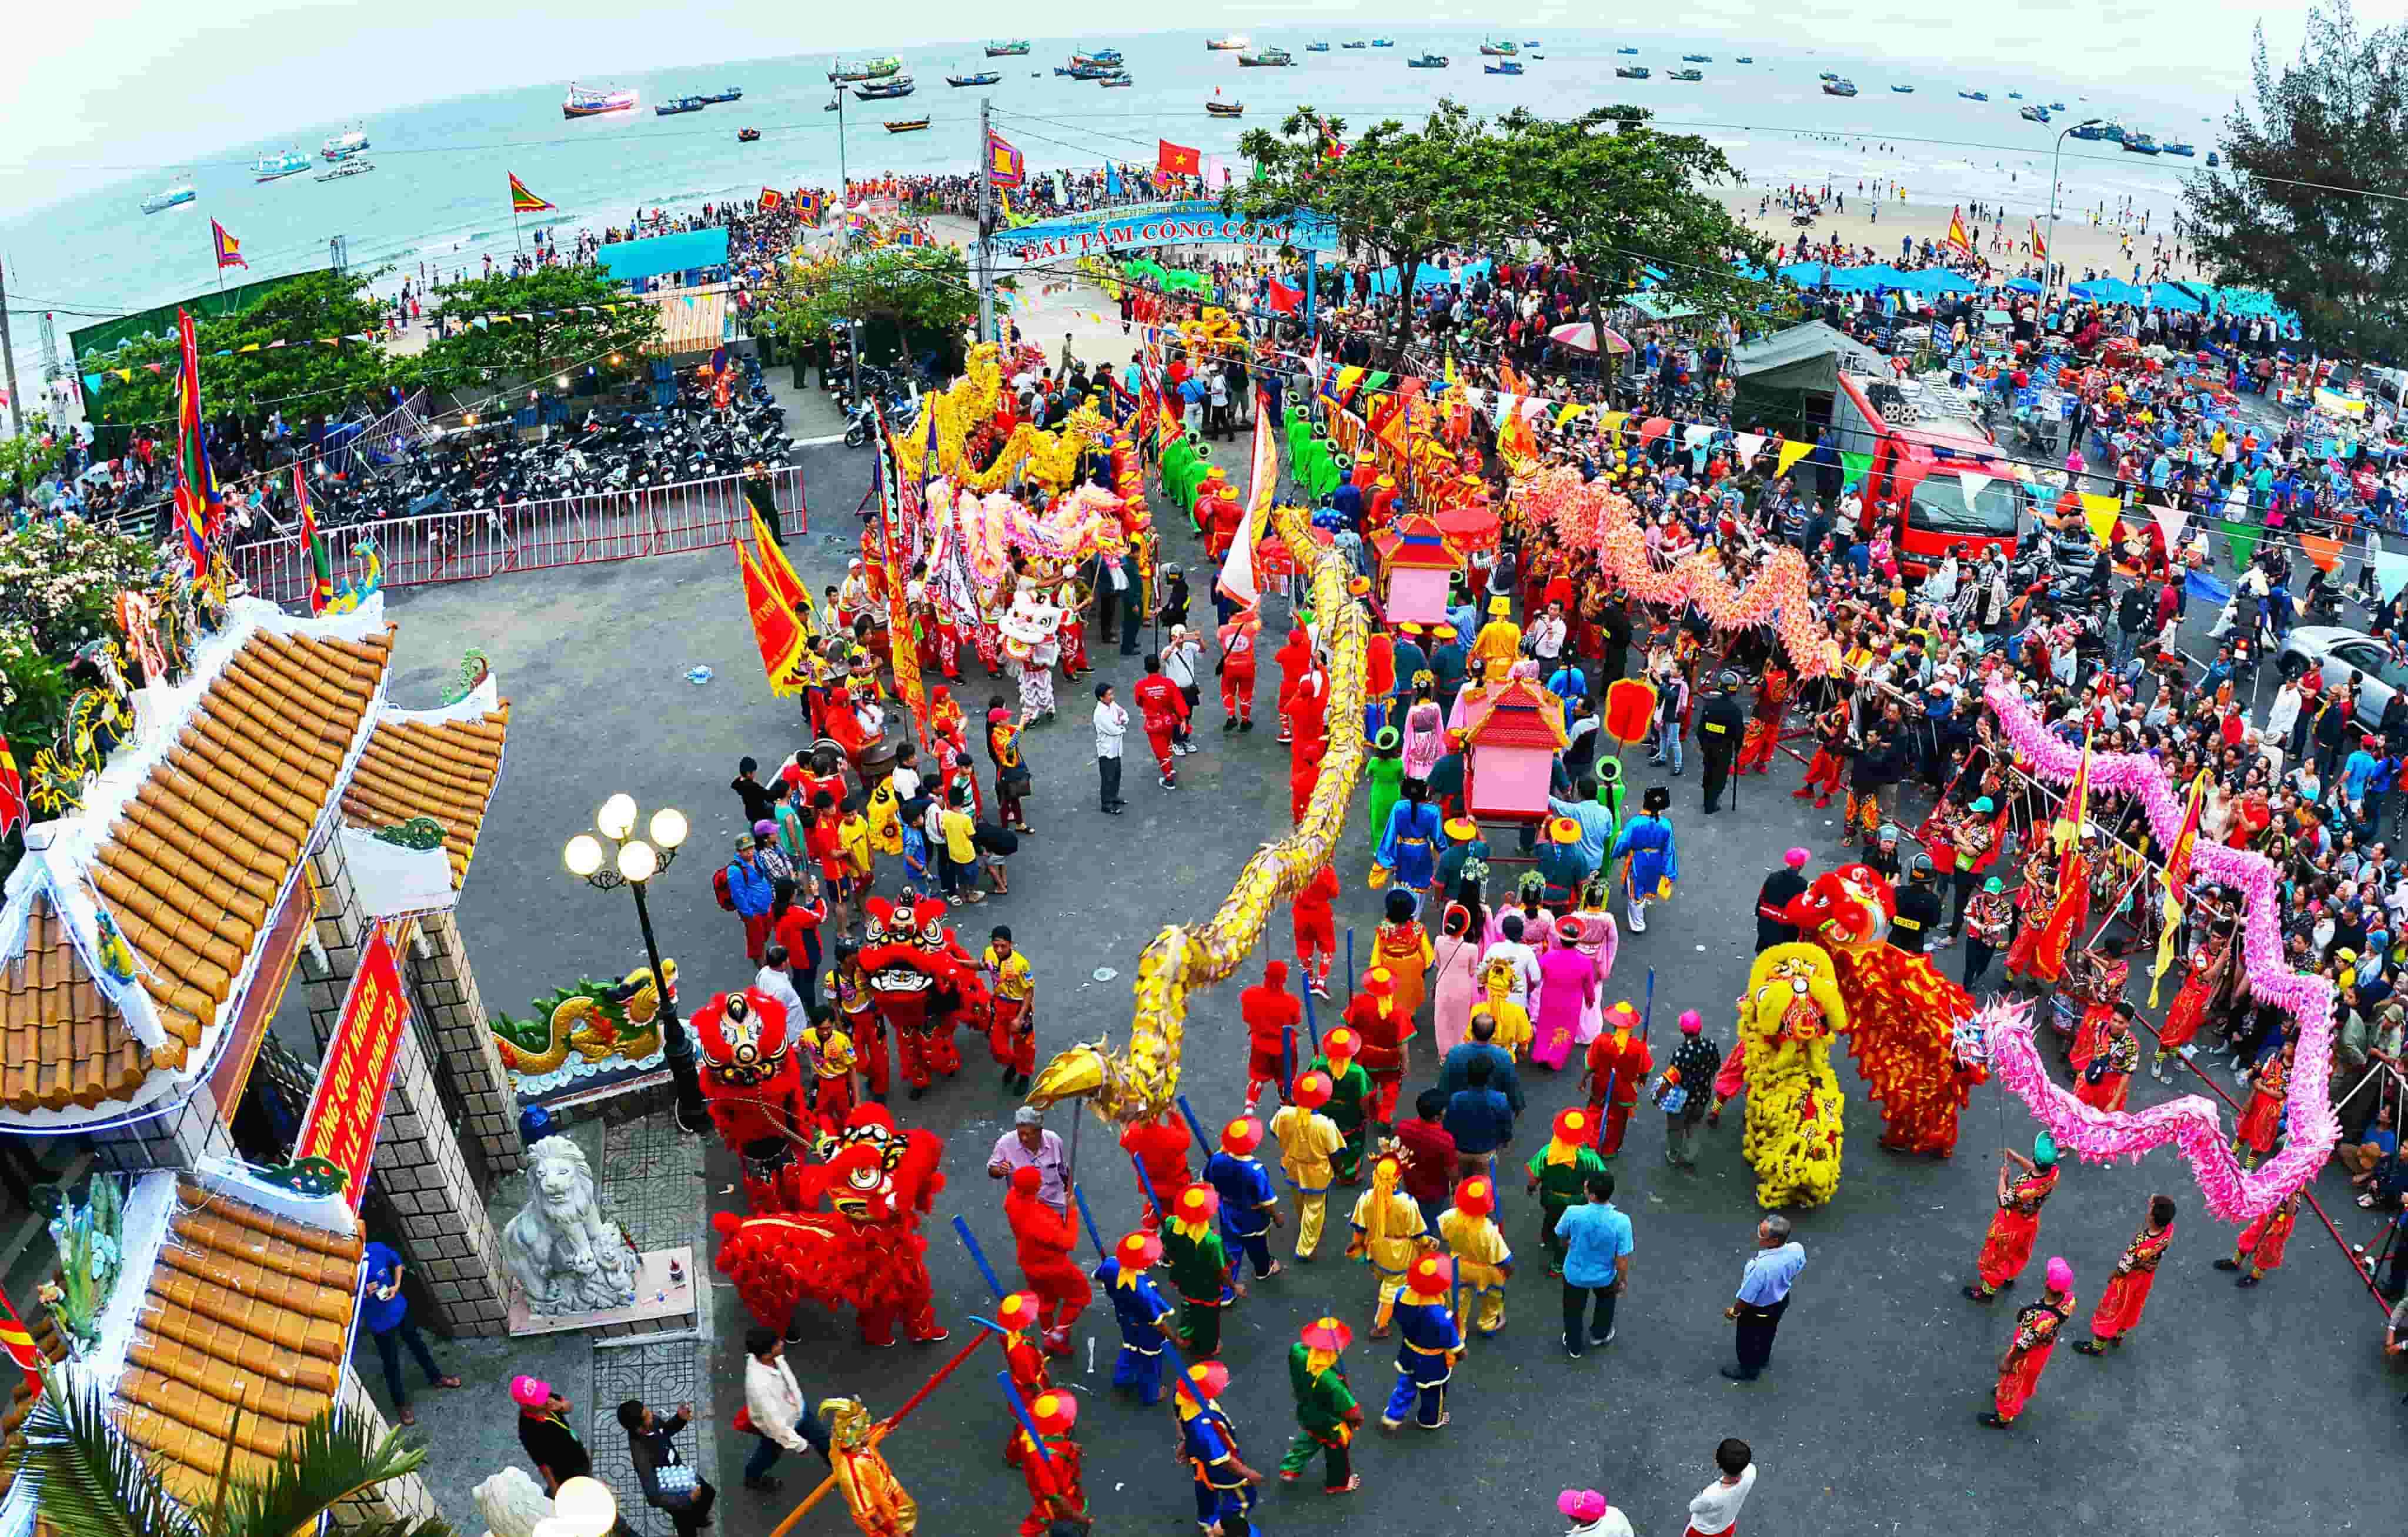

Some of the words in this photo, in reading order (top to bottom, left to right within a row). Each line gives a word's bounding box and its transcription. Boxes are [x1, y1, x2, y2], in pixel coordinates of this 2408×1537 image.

[1021, 237, 1071, 263] BÃI
[1076, 221, 1134, 250] TẮM
[1143, 218, 1214, 240] CÔNG
[333, 1040, 355, 1104] QUÝ
[349, 971, 378, 1057] KHÁCH
[354, 1075, 375, 1131] HỘI
[368, 1023, 389, 1089] DINH
[384, 990, 398, 1034] CÔ
